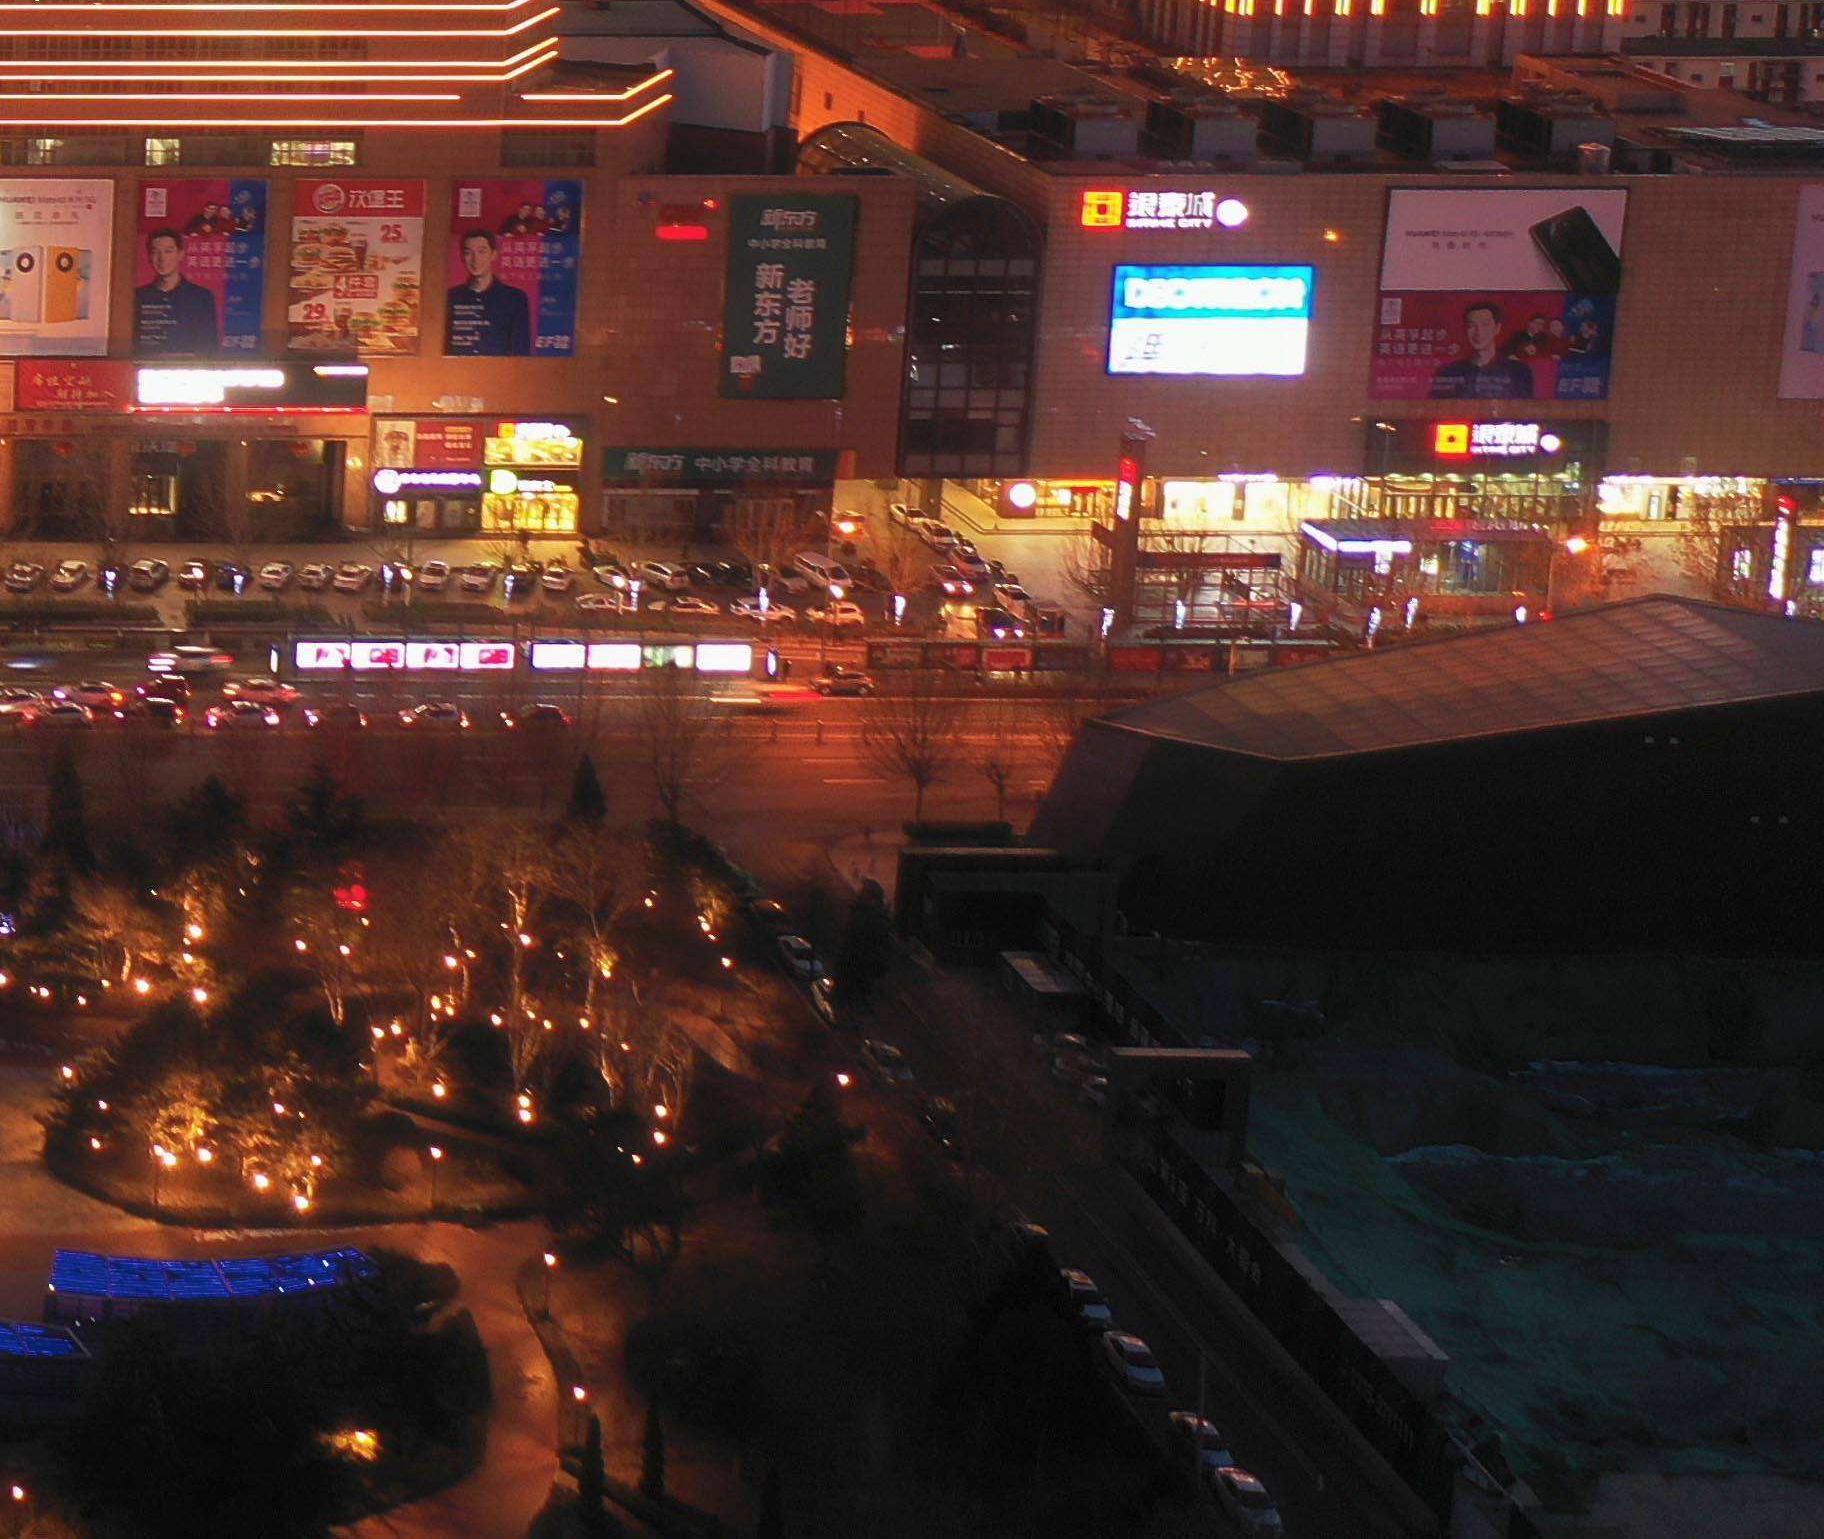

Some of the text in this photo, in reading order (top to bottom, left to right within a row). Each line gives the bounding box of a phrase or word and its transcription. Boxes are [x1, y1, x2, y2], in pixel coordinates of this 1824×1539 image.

[753, 263, 784, 345] 新东方
[783, 278, 816, 359] 老师好
